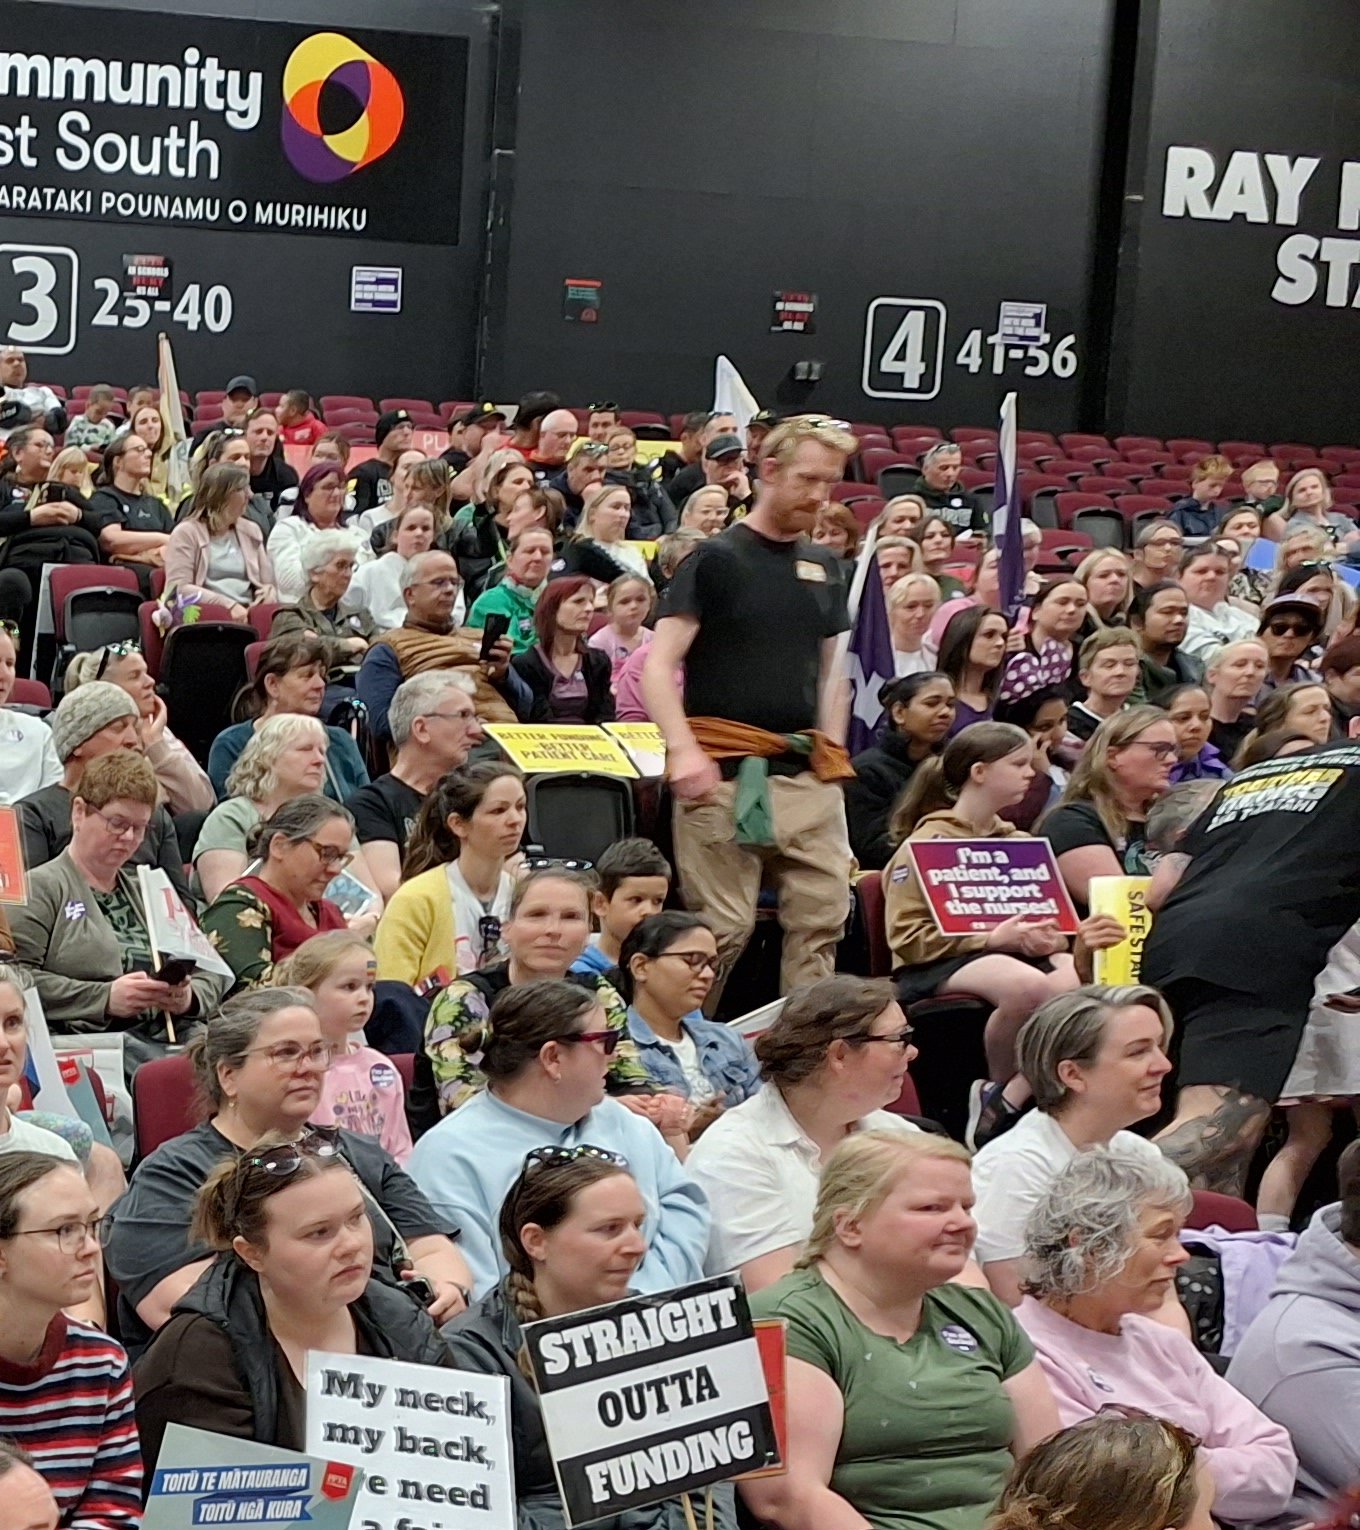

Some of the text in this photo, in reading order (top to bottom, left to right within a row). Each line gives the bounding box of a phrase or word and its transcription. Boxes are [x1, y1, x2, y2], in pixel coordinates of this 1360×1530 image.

[55, 111, 220, 182] South
[101, 190, 221, 223] POUNAMU
[228, 200, 247, 223] O
[254, 202, 368, 231] MURIHIKU
[1162, 146, 1323, 226] RAY
[7, 256, 58, 343] 3
[91, 277, 233, 333] 25-40
[880, 310, 926, 389] 4
[956, 329, 1078, 379] 41-56
[928, 863, 1050, 885] patient, and
[957, 847, 1009, 864] I'm a
[945, 897, 1060, 915] the nurses!
[961, 883, 1043, 901] support
[1128, 891, 1145, 934] SAFE
[538, 1287, 738, 1376] STRAIGHT
[320, 1367, 497, 1426] My neck,
[597, 1364, 720, 1429] OUTTA
[323, 1420, 497, 1471] my back,
[585, 1420, 755, 1503] FUNDING
[162, 1471, 198, 1493] TOITŪ
[201, 1470, 217, 1491] TE
[397, 1477, 492, 1512] need
[199, 1500, 303, 1522] TOITŪ NGĀ KURA
